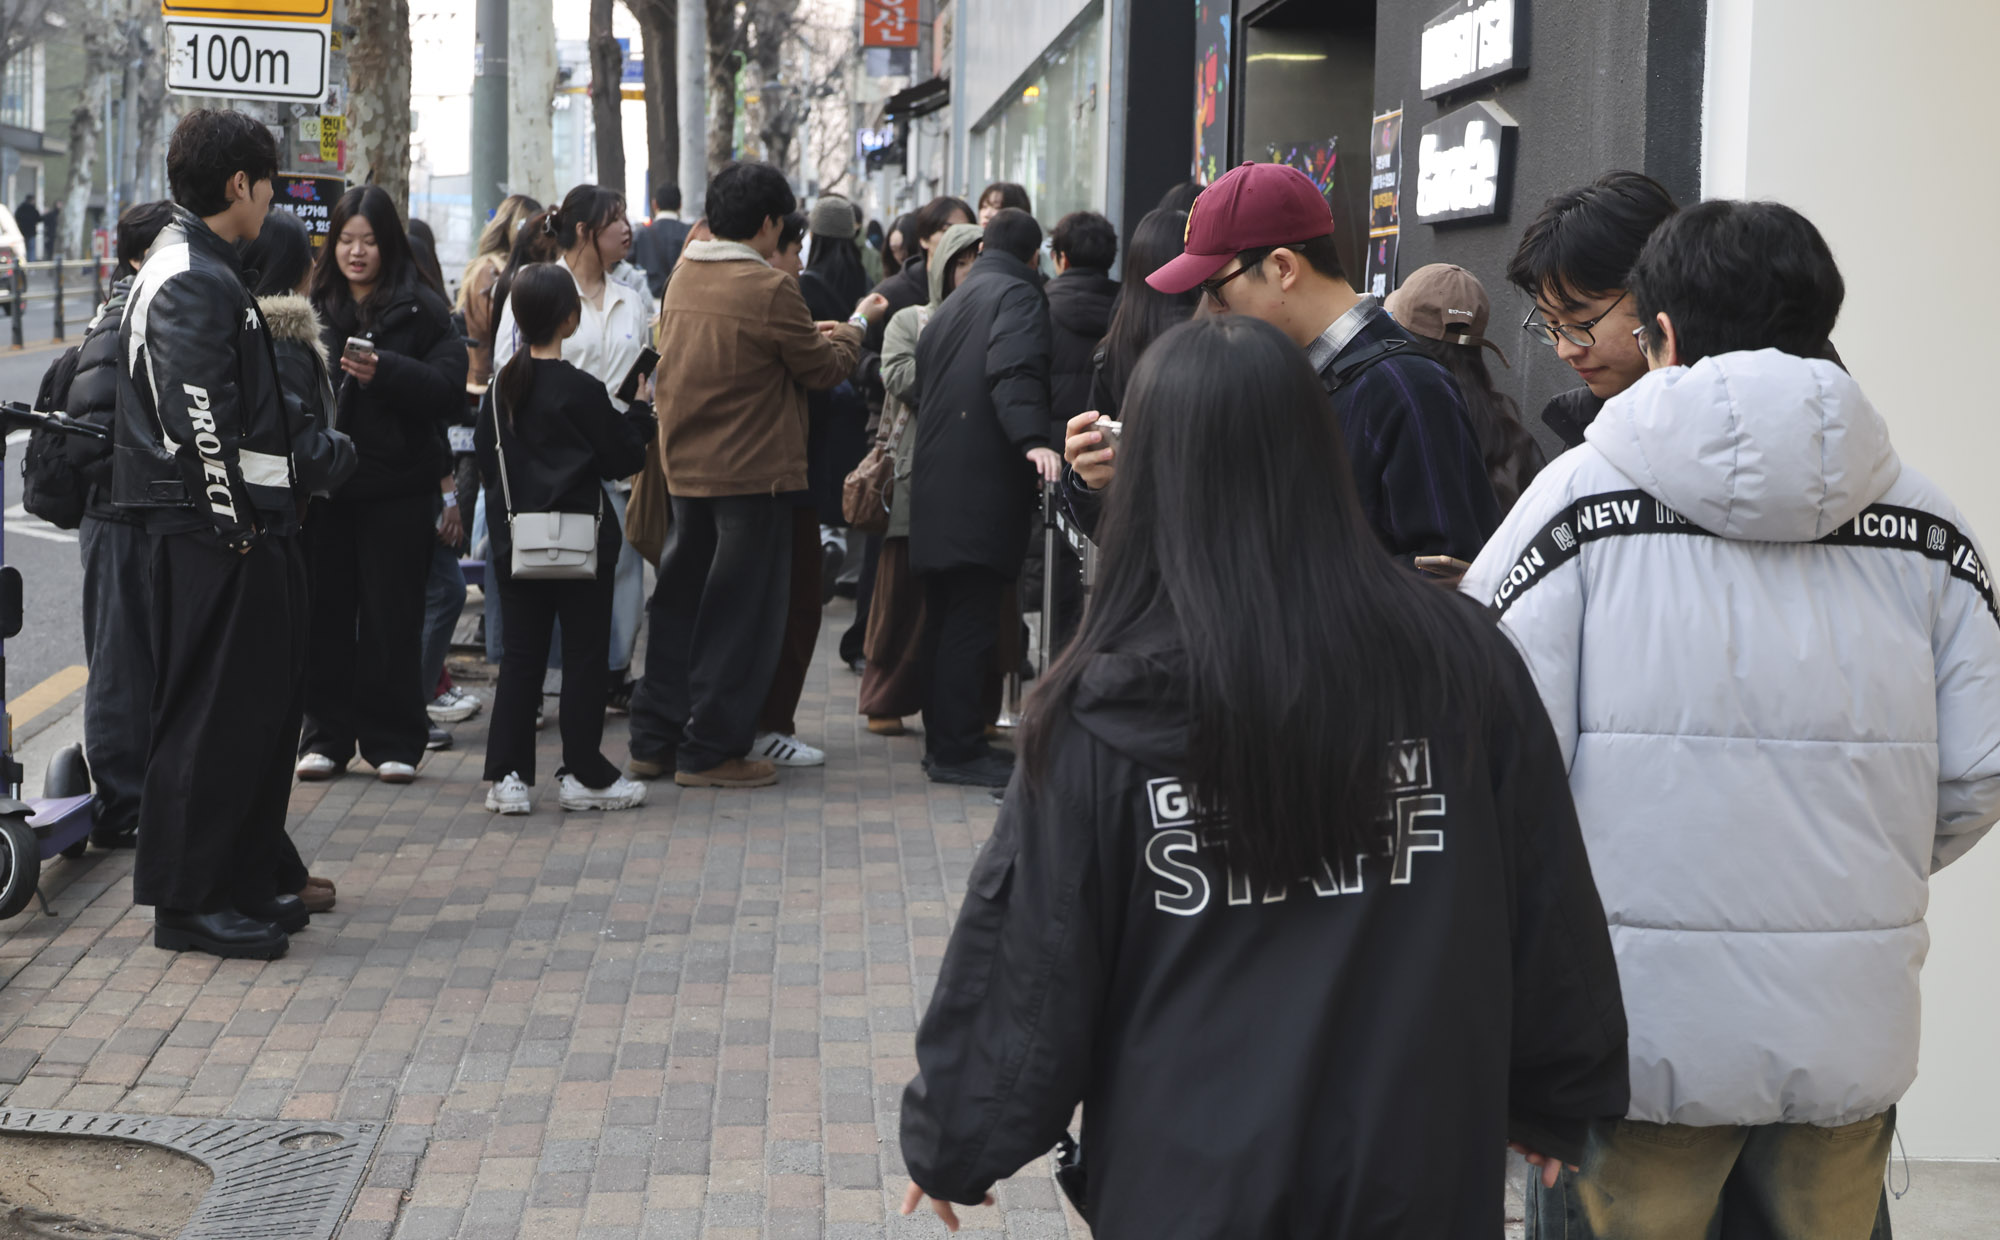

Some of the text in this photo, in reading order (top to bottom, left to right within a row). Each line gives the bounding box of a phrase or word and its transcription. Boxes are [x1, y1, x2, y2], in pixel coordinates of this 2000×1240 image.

[186, 34, 289, 85] 100m
[870, 0, 910, 41] 산
[182, 383, 238, 523] PROJECT
[1494, 547, 1545, 609] ICON
[1577, 499, 1640, 533] NEW
[1854, 513, 1918, 542] ICON
